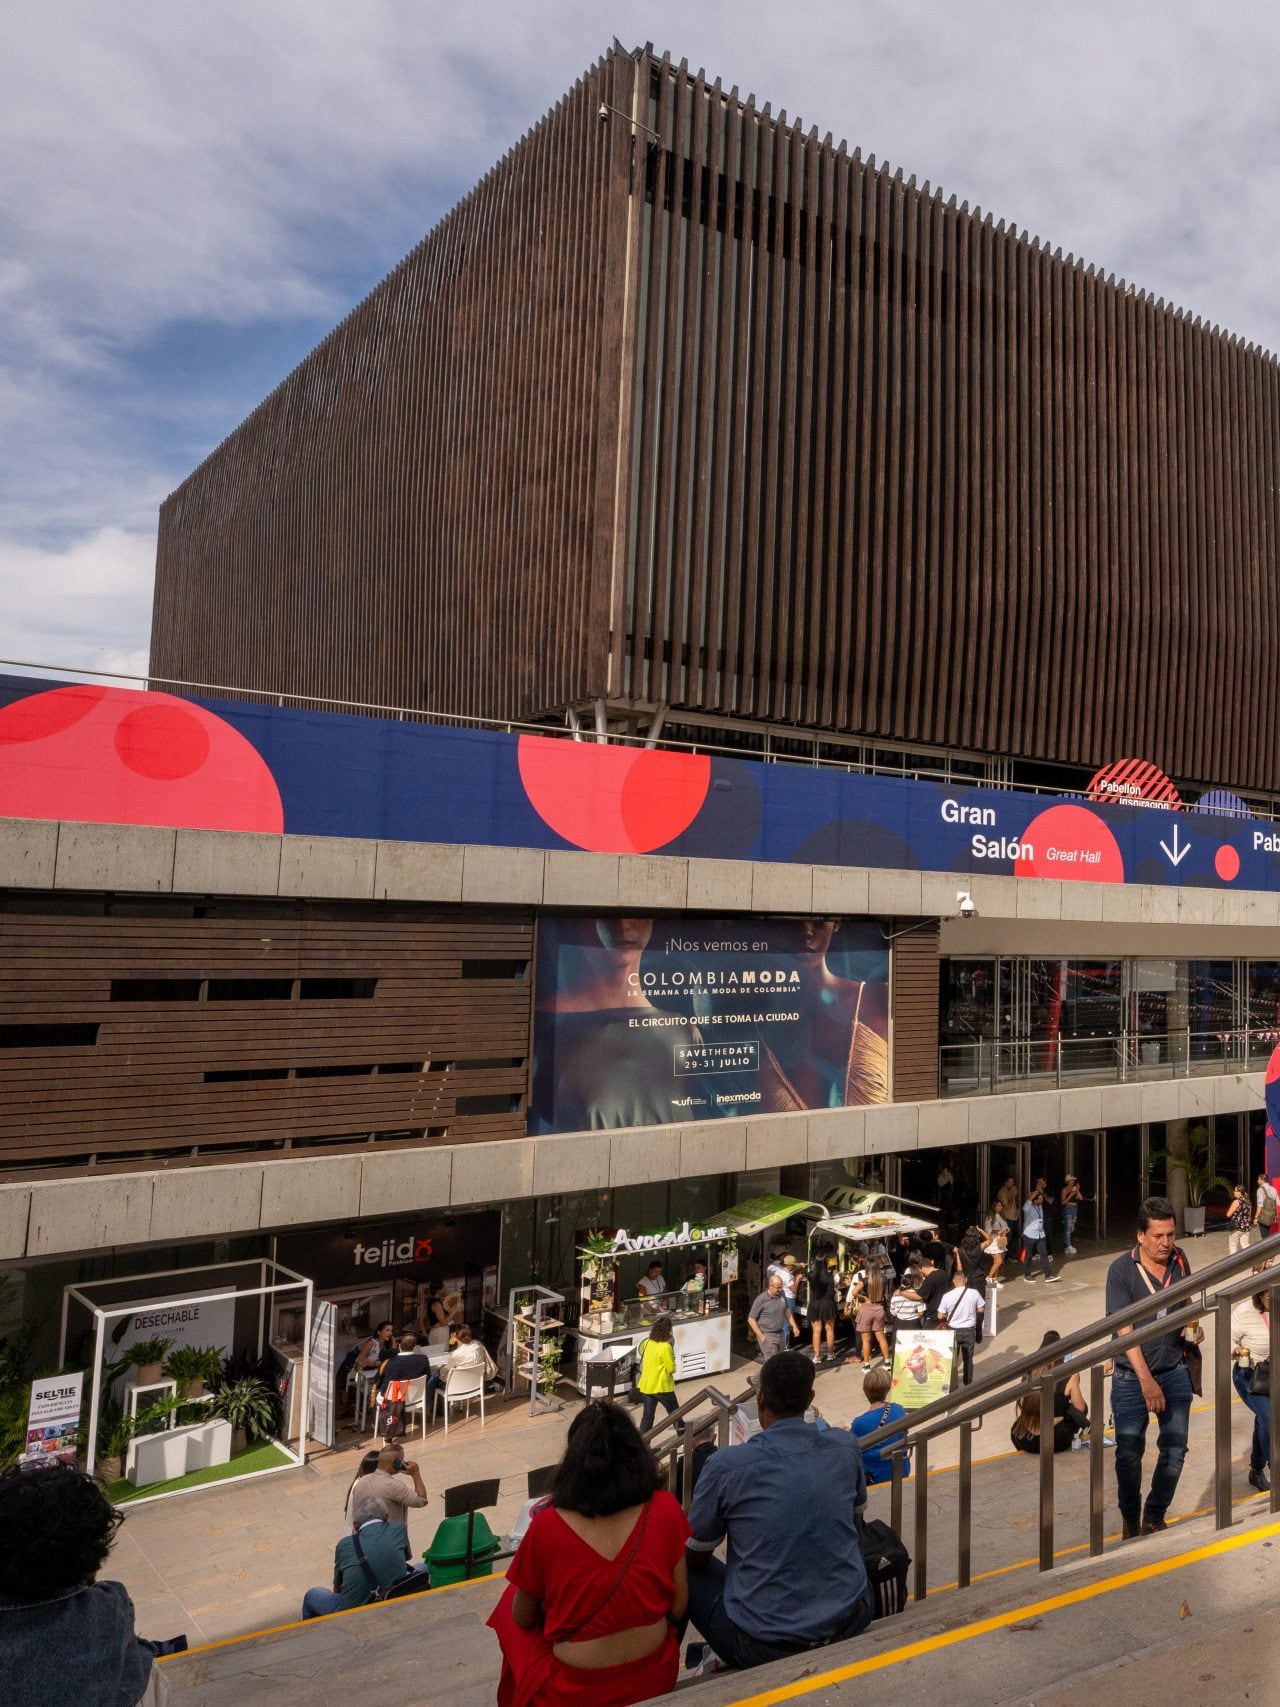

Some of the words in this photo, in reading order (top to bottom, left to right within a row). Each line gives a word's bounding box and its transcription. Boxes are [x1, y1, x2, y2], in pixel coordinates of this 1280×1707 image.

[941, 798, 996, 826] Gran
[971, 834, 1034, 861] Salón
[1046, 847, 1078, 862] Great
[1079, 849, 1102, 864] Hall
[665, 938, 699, 955] ¡Nos
[703, 941, 749, 951] vemos
[752, 941, 768, 951] en
[627, 970, 800, 986] COLOMBIAMODA
[628, 1018, 640, 1028] EL
[641, 1016, 688, 1027] CIRCUITO
[689, 1016, 710, 1026] QUE
[712, 1015, 723, 1024] SE
[725, 1014, 751, 1023] TOMA
[753, 1013, 765, 1022] LA
[765, 1012, 800, 1022] CIUDAD
[684, 1060, 715, 1069] 29-31
[720, 1057, 750, 1068] JULIO
[716, 1091, 762, 1103] inexmoda
[134, 1308, 200, 1330] DESECHABLE
